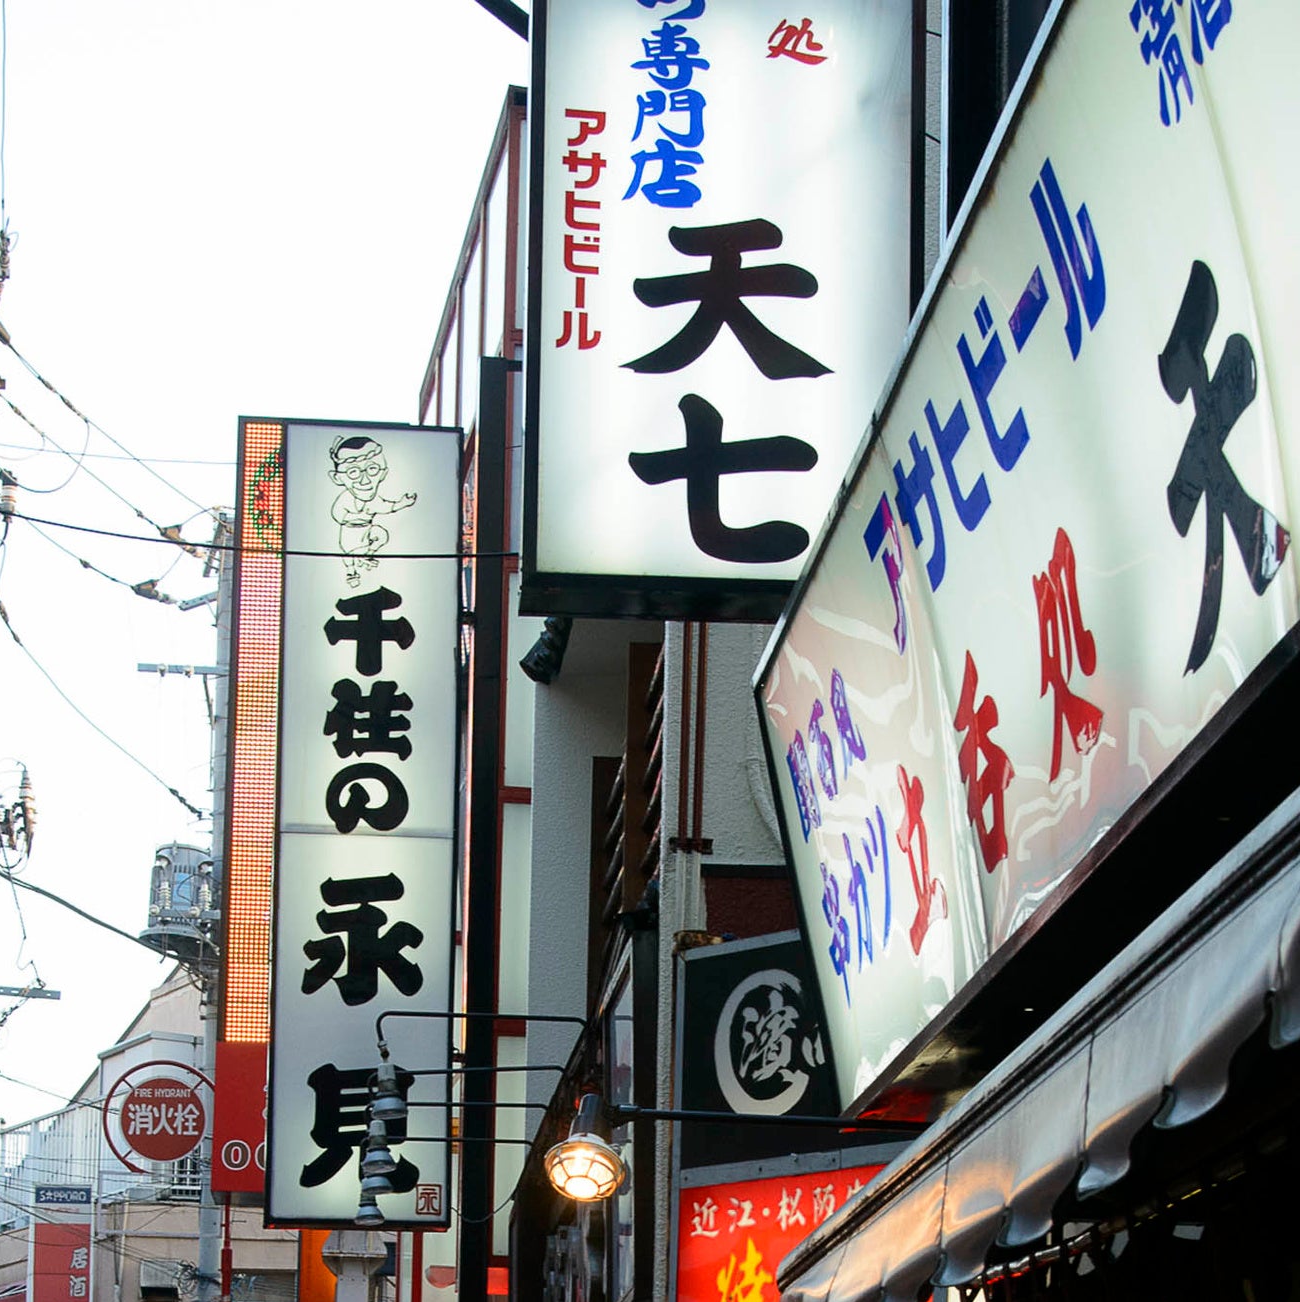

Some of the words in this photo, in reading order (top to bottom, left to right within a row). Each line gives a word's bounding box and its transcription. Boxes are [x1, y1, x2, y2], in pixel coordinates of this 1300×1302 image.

[555, 108, 607, 350] アサヒビール
[617, 217, 836, 564] 天七
[864, 157, 1107, 655] アサヒビール
[896, 526, 1105, 956] 立呑処
[127, 1103, 200, 1136] 消火栓
[134, 1088, 153, 1098] FIRE
[154, 1088, 191, 1099] HYDRANT
